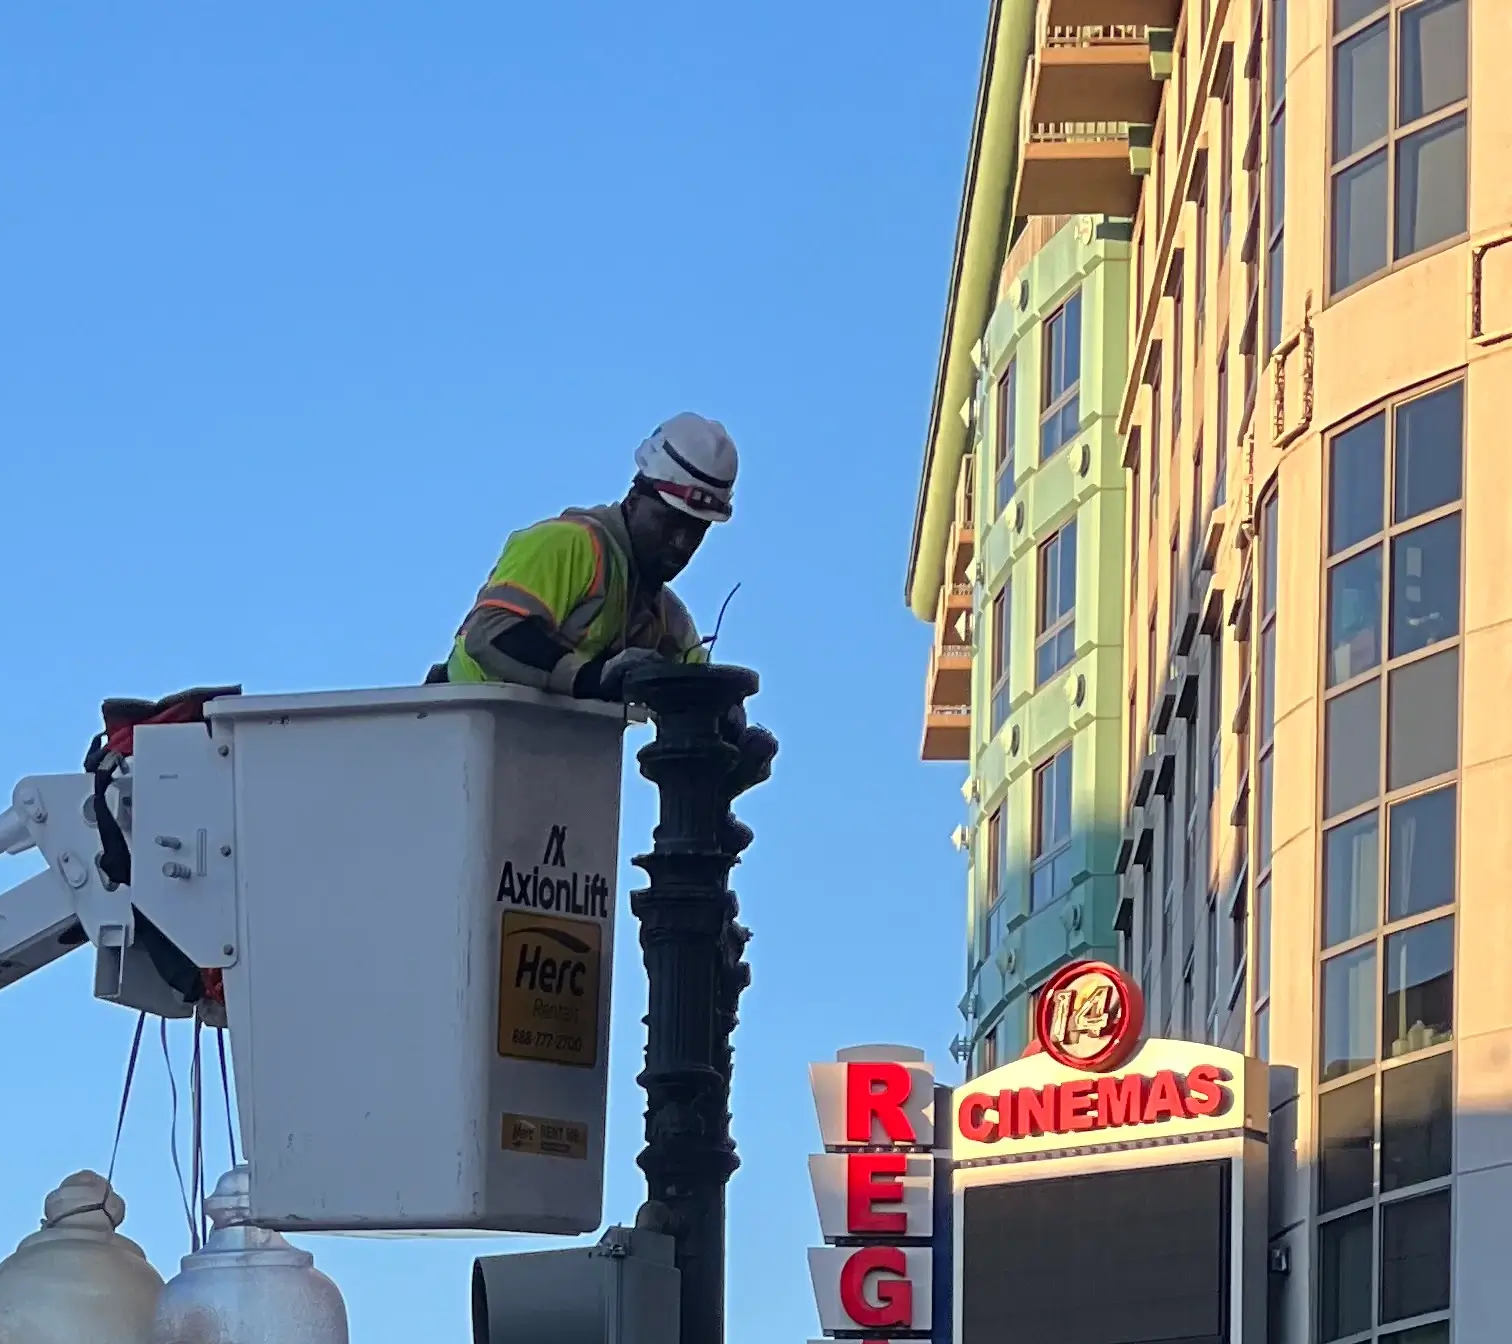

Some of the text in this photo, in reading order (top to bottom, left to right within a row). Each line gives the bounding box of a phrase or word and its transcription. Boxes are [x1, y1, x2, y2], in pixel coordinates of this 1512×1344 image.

[496, 861, 609, 918] AxionLift
[515, 943, 586, 997] Herc
[1050, 985, 1113, 1044] 14
[958, 1064, 1230, 1143] CINEMAS
